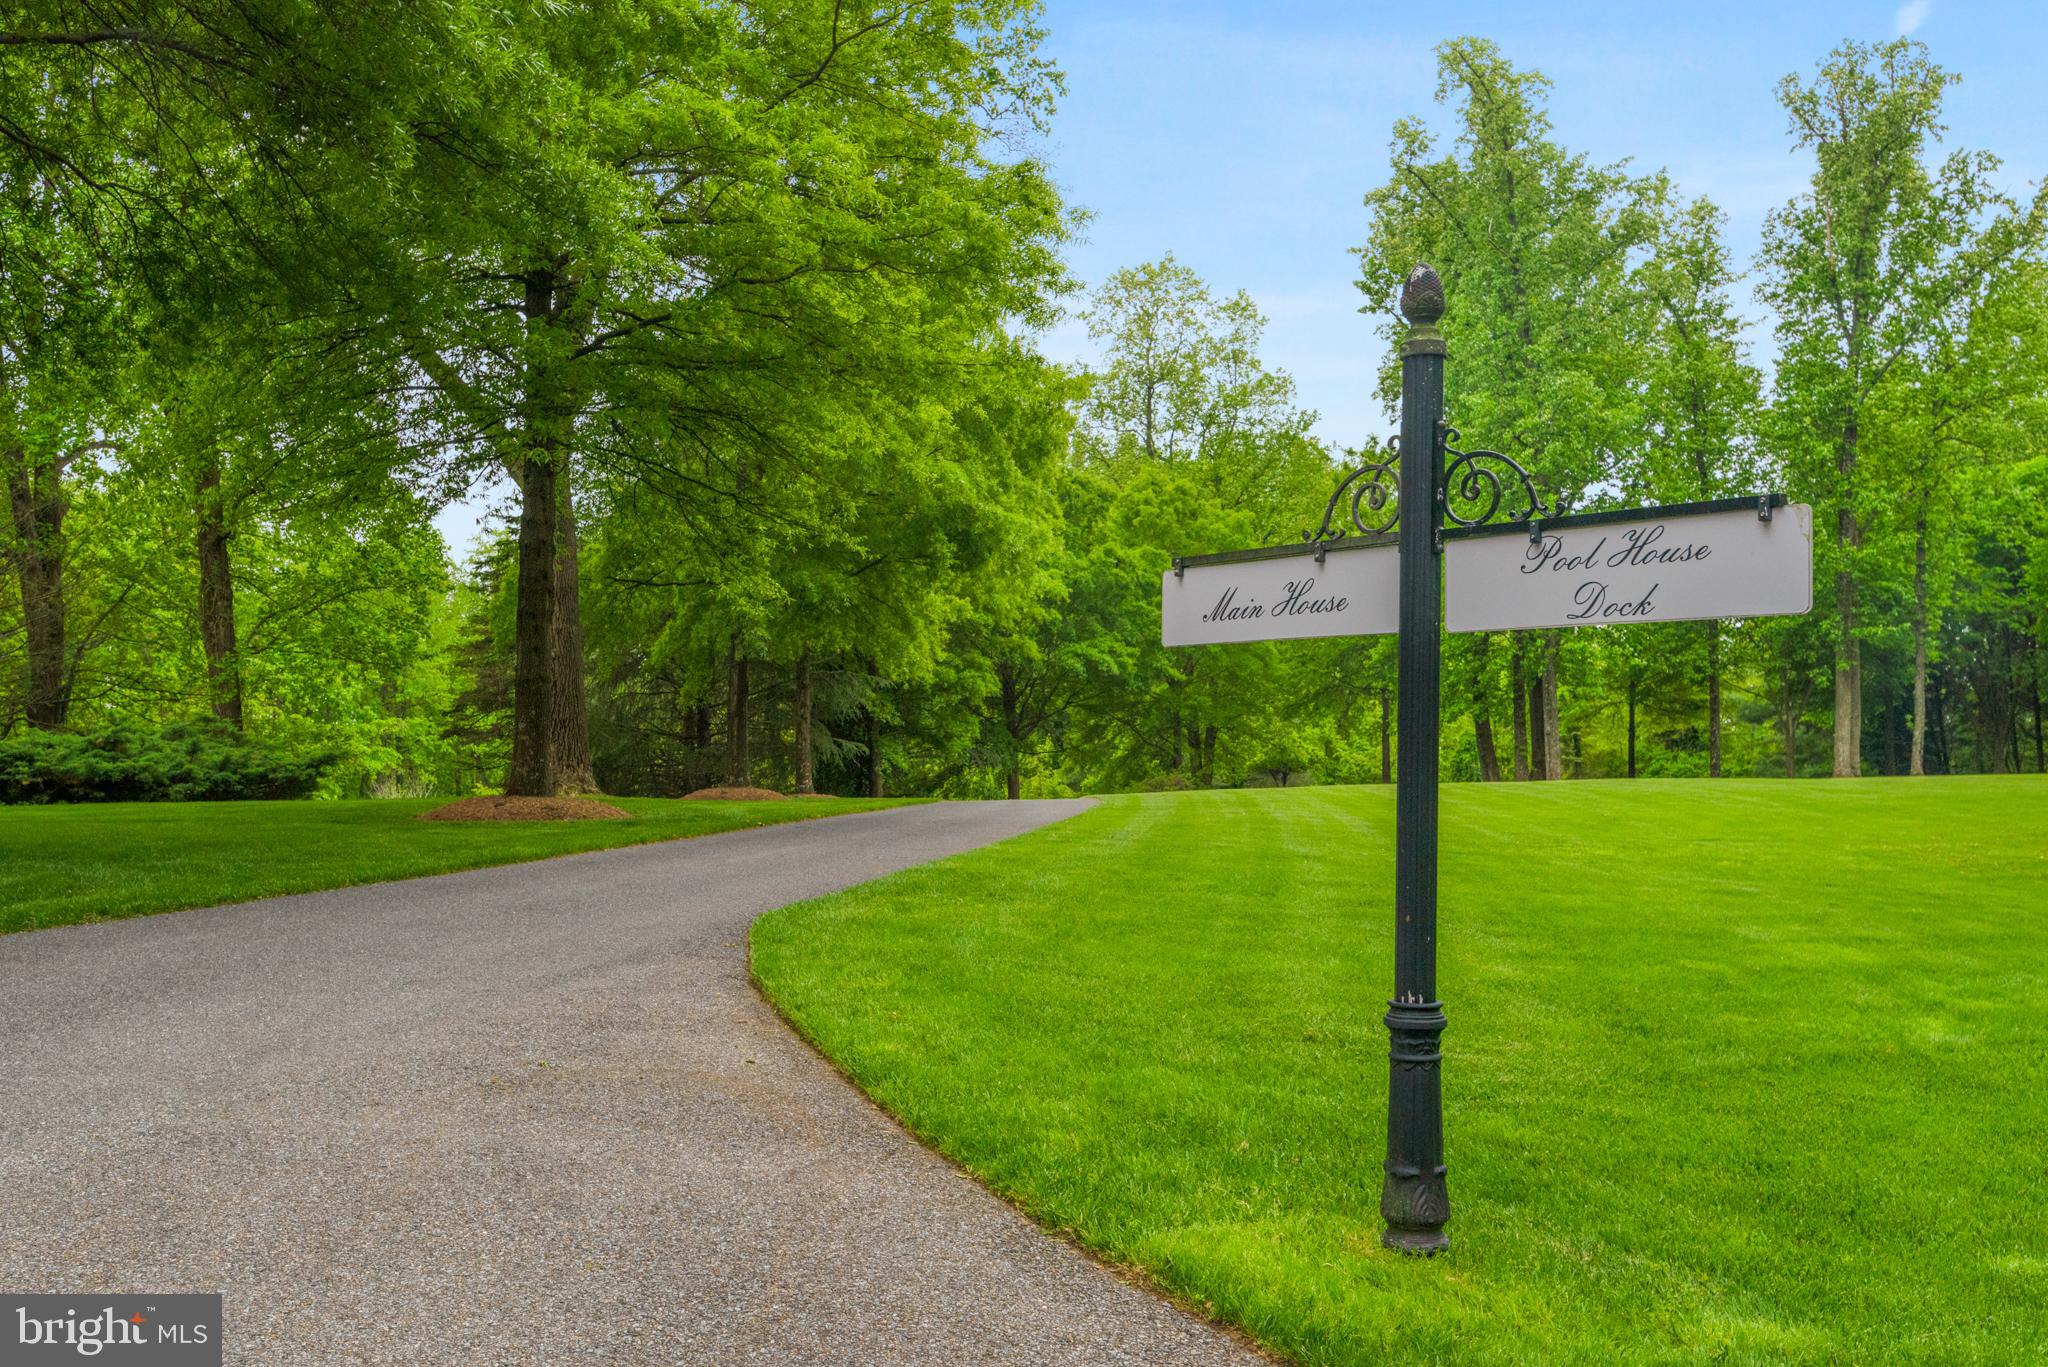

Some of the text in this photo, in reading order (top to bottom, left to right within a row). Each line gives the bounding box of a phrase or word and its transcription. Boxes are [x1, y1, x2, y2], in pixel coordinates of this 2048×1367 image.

[1520, 524, 1712, 574] Pool House
[1202, 577, 1351, 624] Main House
[1566, 581, 1659, 620] Dock
